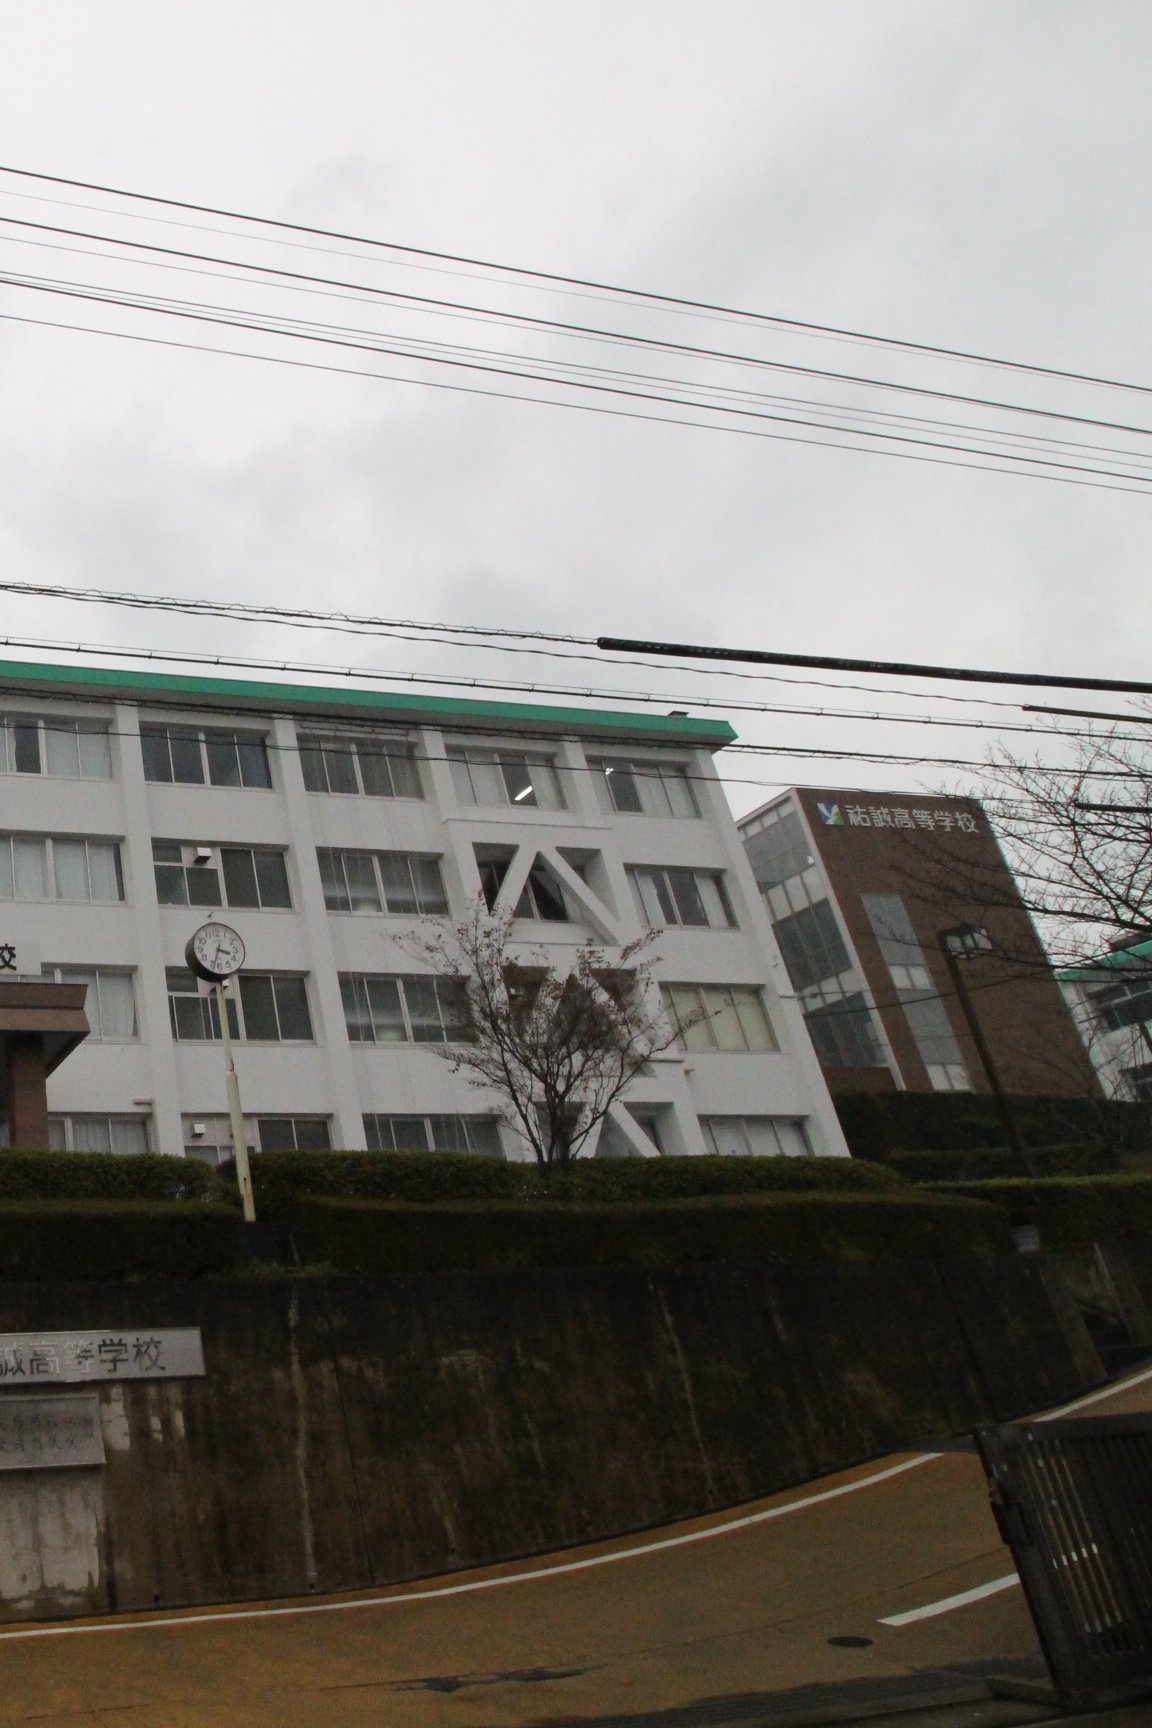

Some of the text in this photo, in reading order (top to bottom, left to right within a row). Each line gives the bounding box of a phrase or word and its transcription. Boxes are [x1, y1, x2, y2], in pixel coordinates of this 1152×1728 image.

[845, 804, 980, 833] 祐誠高等学校
